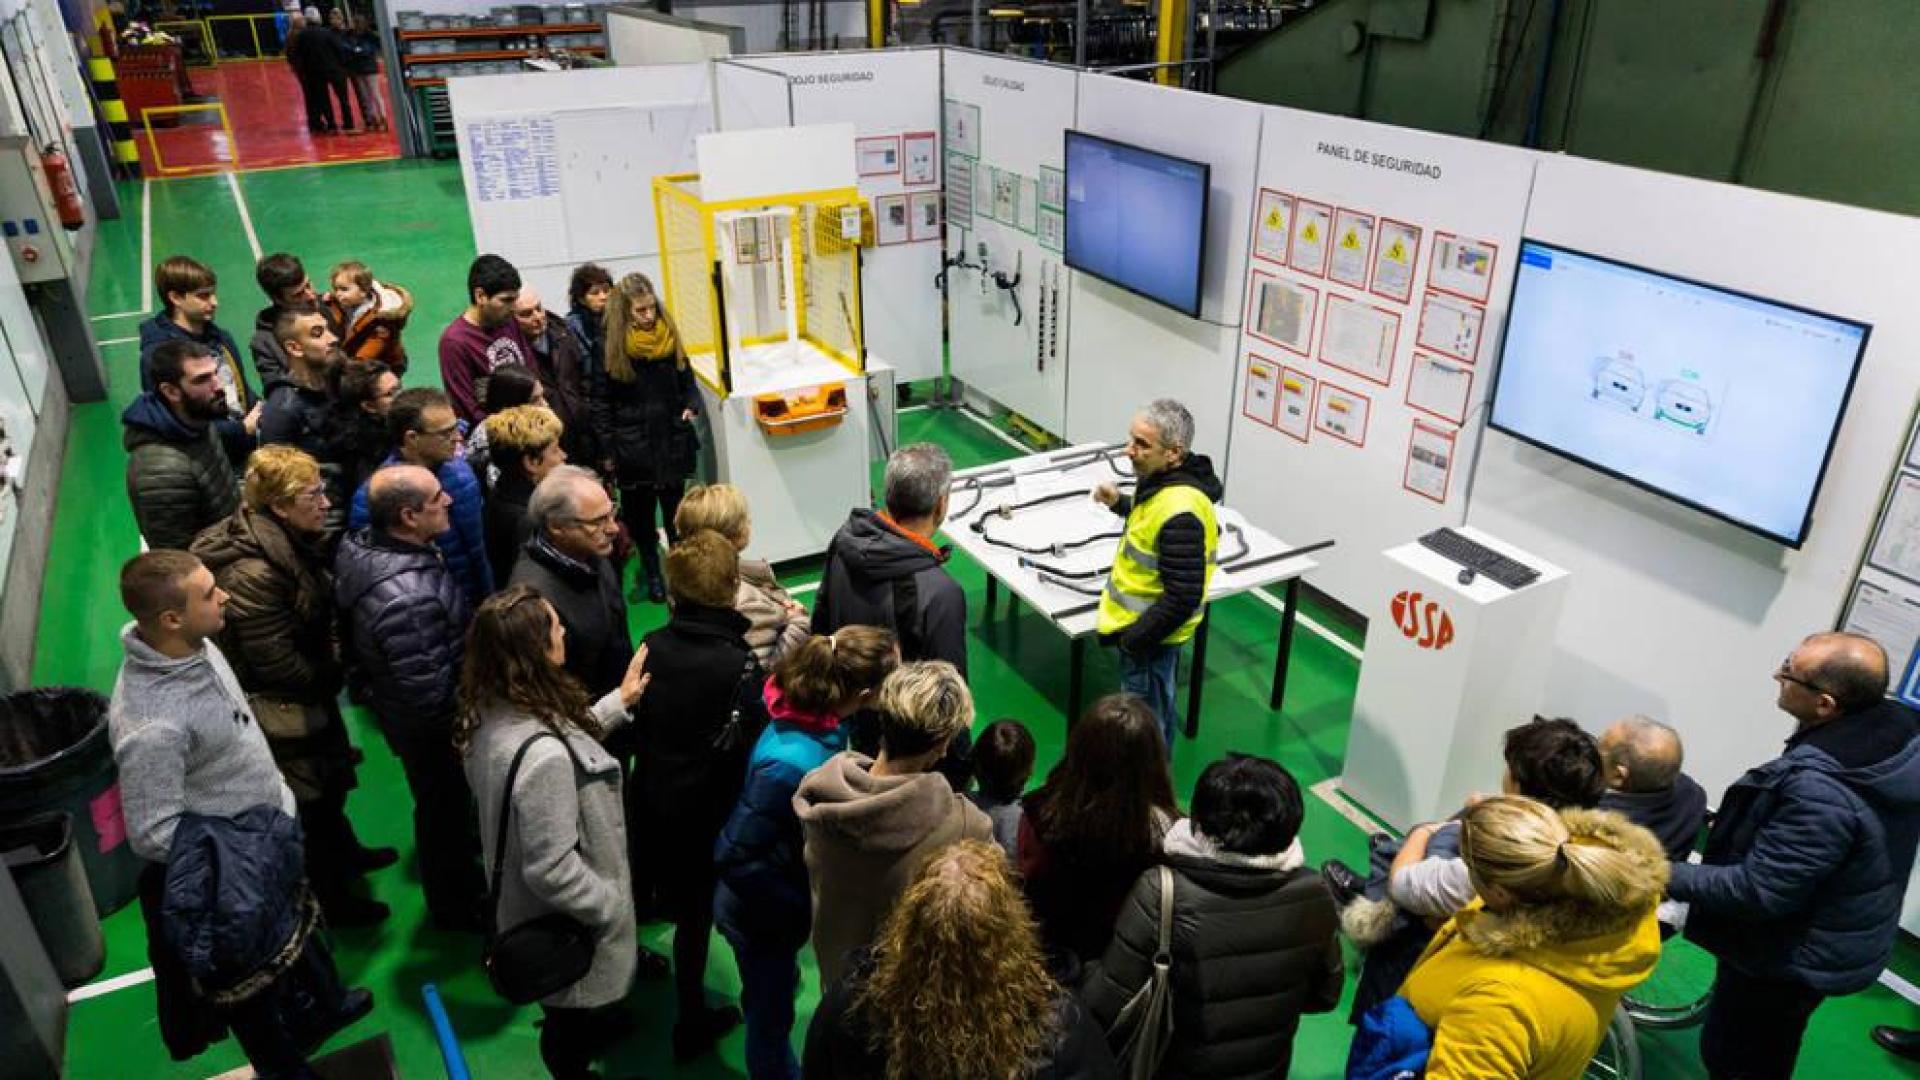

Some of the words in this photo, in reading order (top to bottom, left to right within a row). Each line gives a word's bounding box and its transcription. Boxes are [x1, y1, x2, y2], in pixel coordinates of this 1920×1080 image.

[1317, 141, 1351, 160] PANEL
[1353, 149, 1370, 163] DE
[1371, 153, 1441, 179] SEGURIDAD
